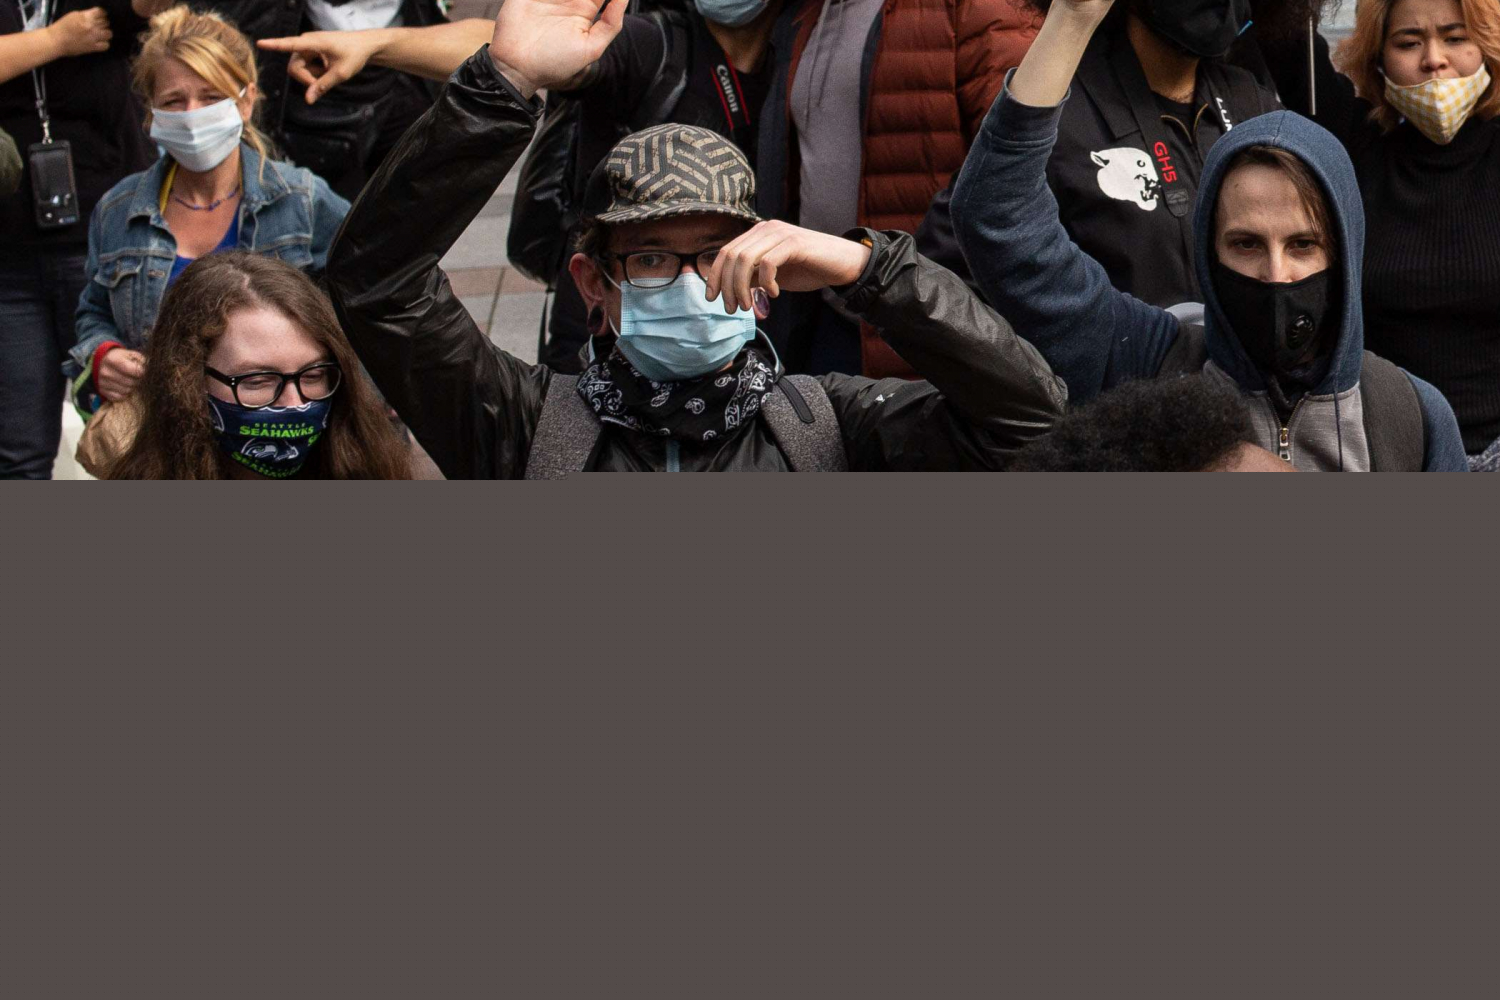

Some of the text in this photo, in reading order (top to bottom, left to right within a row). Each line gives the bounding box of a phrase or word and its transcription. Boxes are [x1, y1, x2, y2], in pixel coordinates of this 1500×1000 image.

[717, 64, 739, 113] Canon
[1154, 141, 1177, 183] GH5
[240, 425, 315, 438] SEAHAWKS
